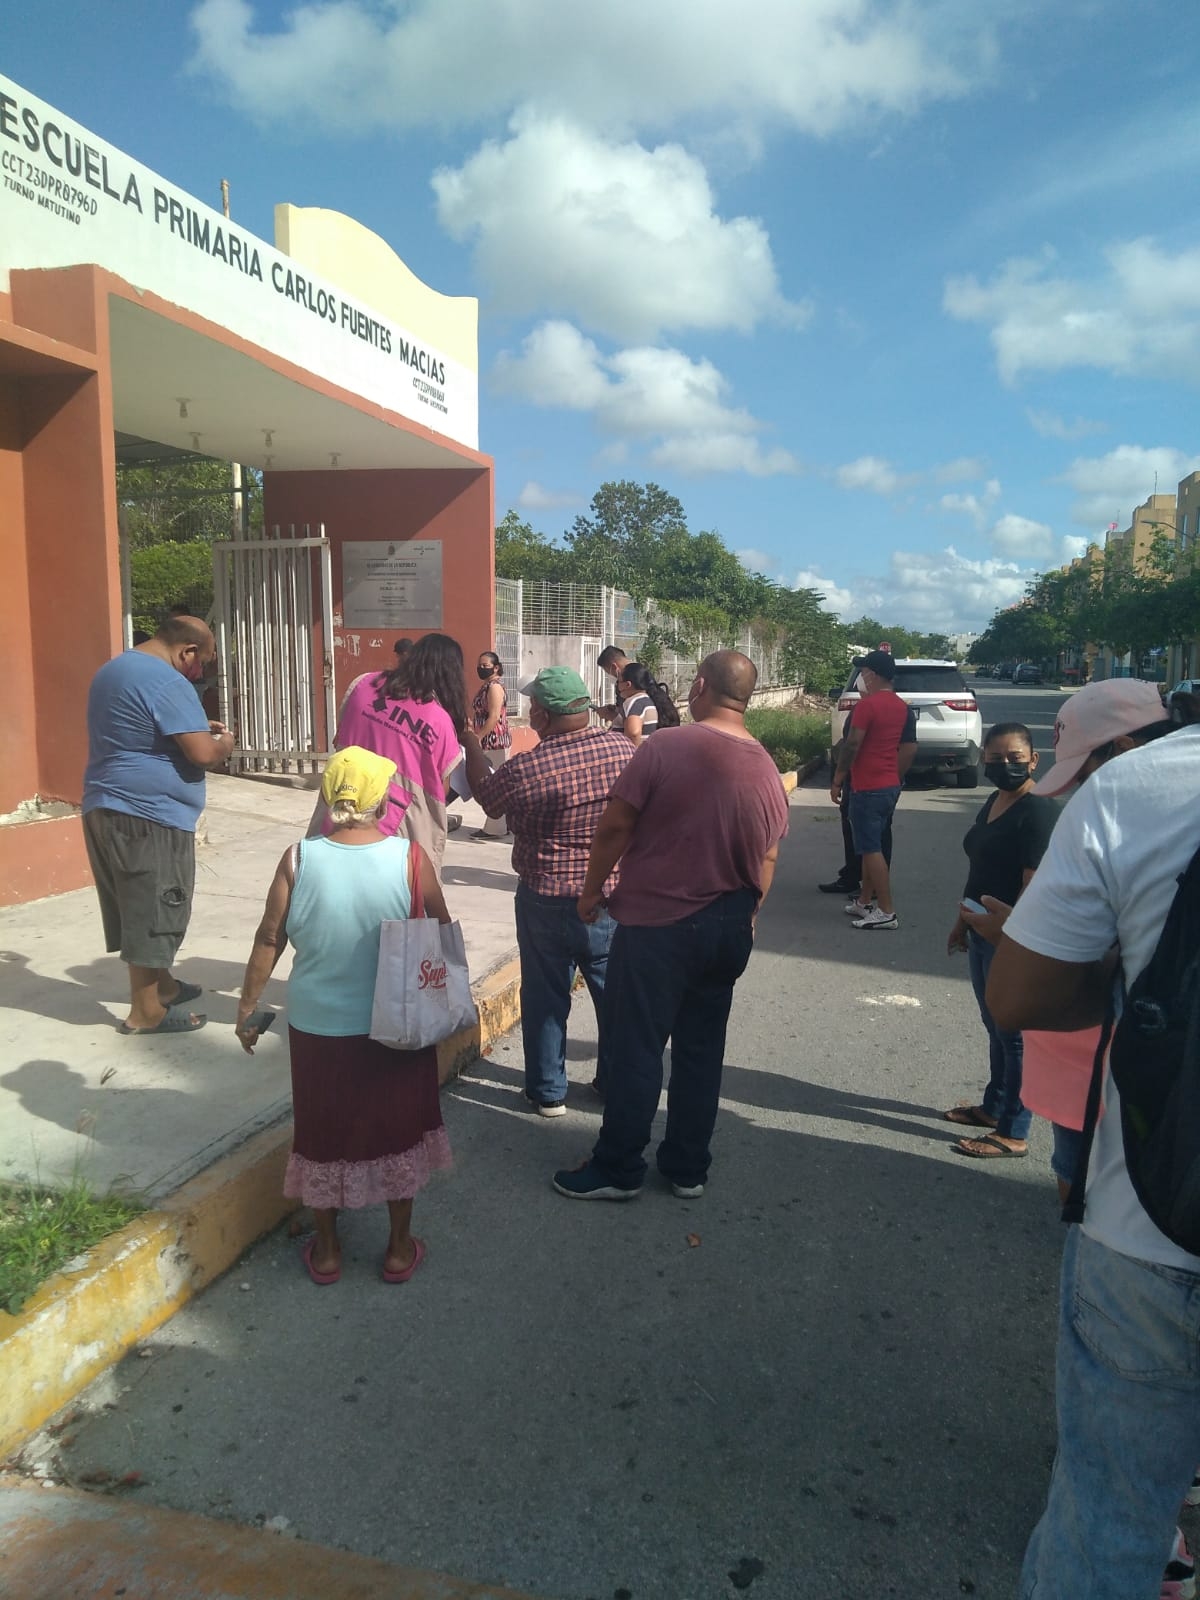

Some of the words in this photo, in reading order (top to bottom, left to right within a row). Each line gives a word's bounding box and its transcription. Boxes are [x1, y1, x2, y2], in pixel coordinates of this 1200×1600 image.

[3, 174, 35, 201] TURNO
[37, 194, 81, 225] MATUTINO
[0, 92, 143, 214] ESCUELA
[153, 187, 263, 282] PRIMARIA
[271, 262, 337, 324] CARLOS
[341, 301, 392, 354] FUENTES
[399, 337, 445, 385] MACIAS
[389, 705, 439, 746] INE
